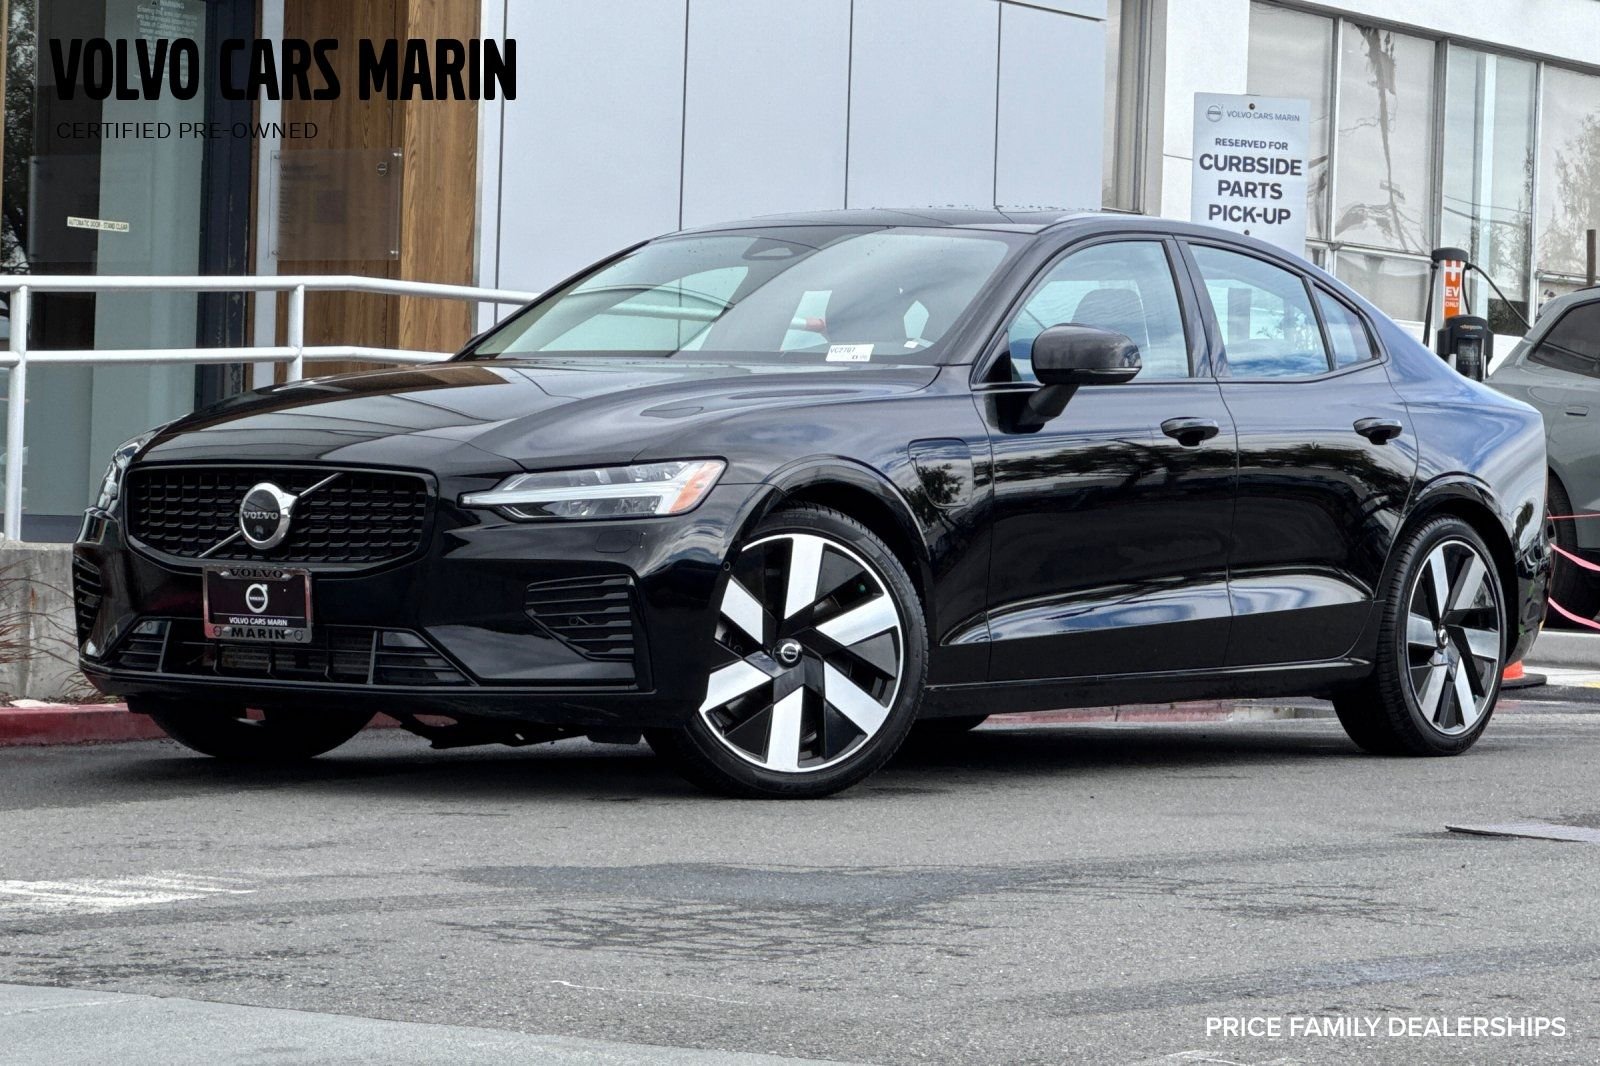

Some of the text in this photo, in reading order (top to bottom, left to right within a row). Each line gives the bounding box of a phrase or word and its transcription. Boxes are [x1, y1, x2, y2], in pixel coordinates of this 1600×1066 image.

[1226, 110, 1252, 119] VOLVO
[1253, 112, 1274, 120] CARS
[1275, 113, 1300, 122] MARIN
[1215, 137, 1288, 151] RESERVED FOR
[1199, 153, 1302, 176] CURBSIDE
[1217, 179, 1283, 200] PARTS
[1208, 203, 1291, 225] PICK-UP
[1445, 286, 1459, 297] EV
[243, 511, 279, 520] VOLVO
[229, 568, 284, 578] VOLVO
[229, 617, 288, 627] VOLVO CARS MARIN
[231, 627, 287, 640] MARIN
